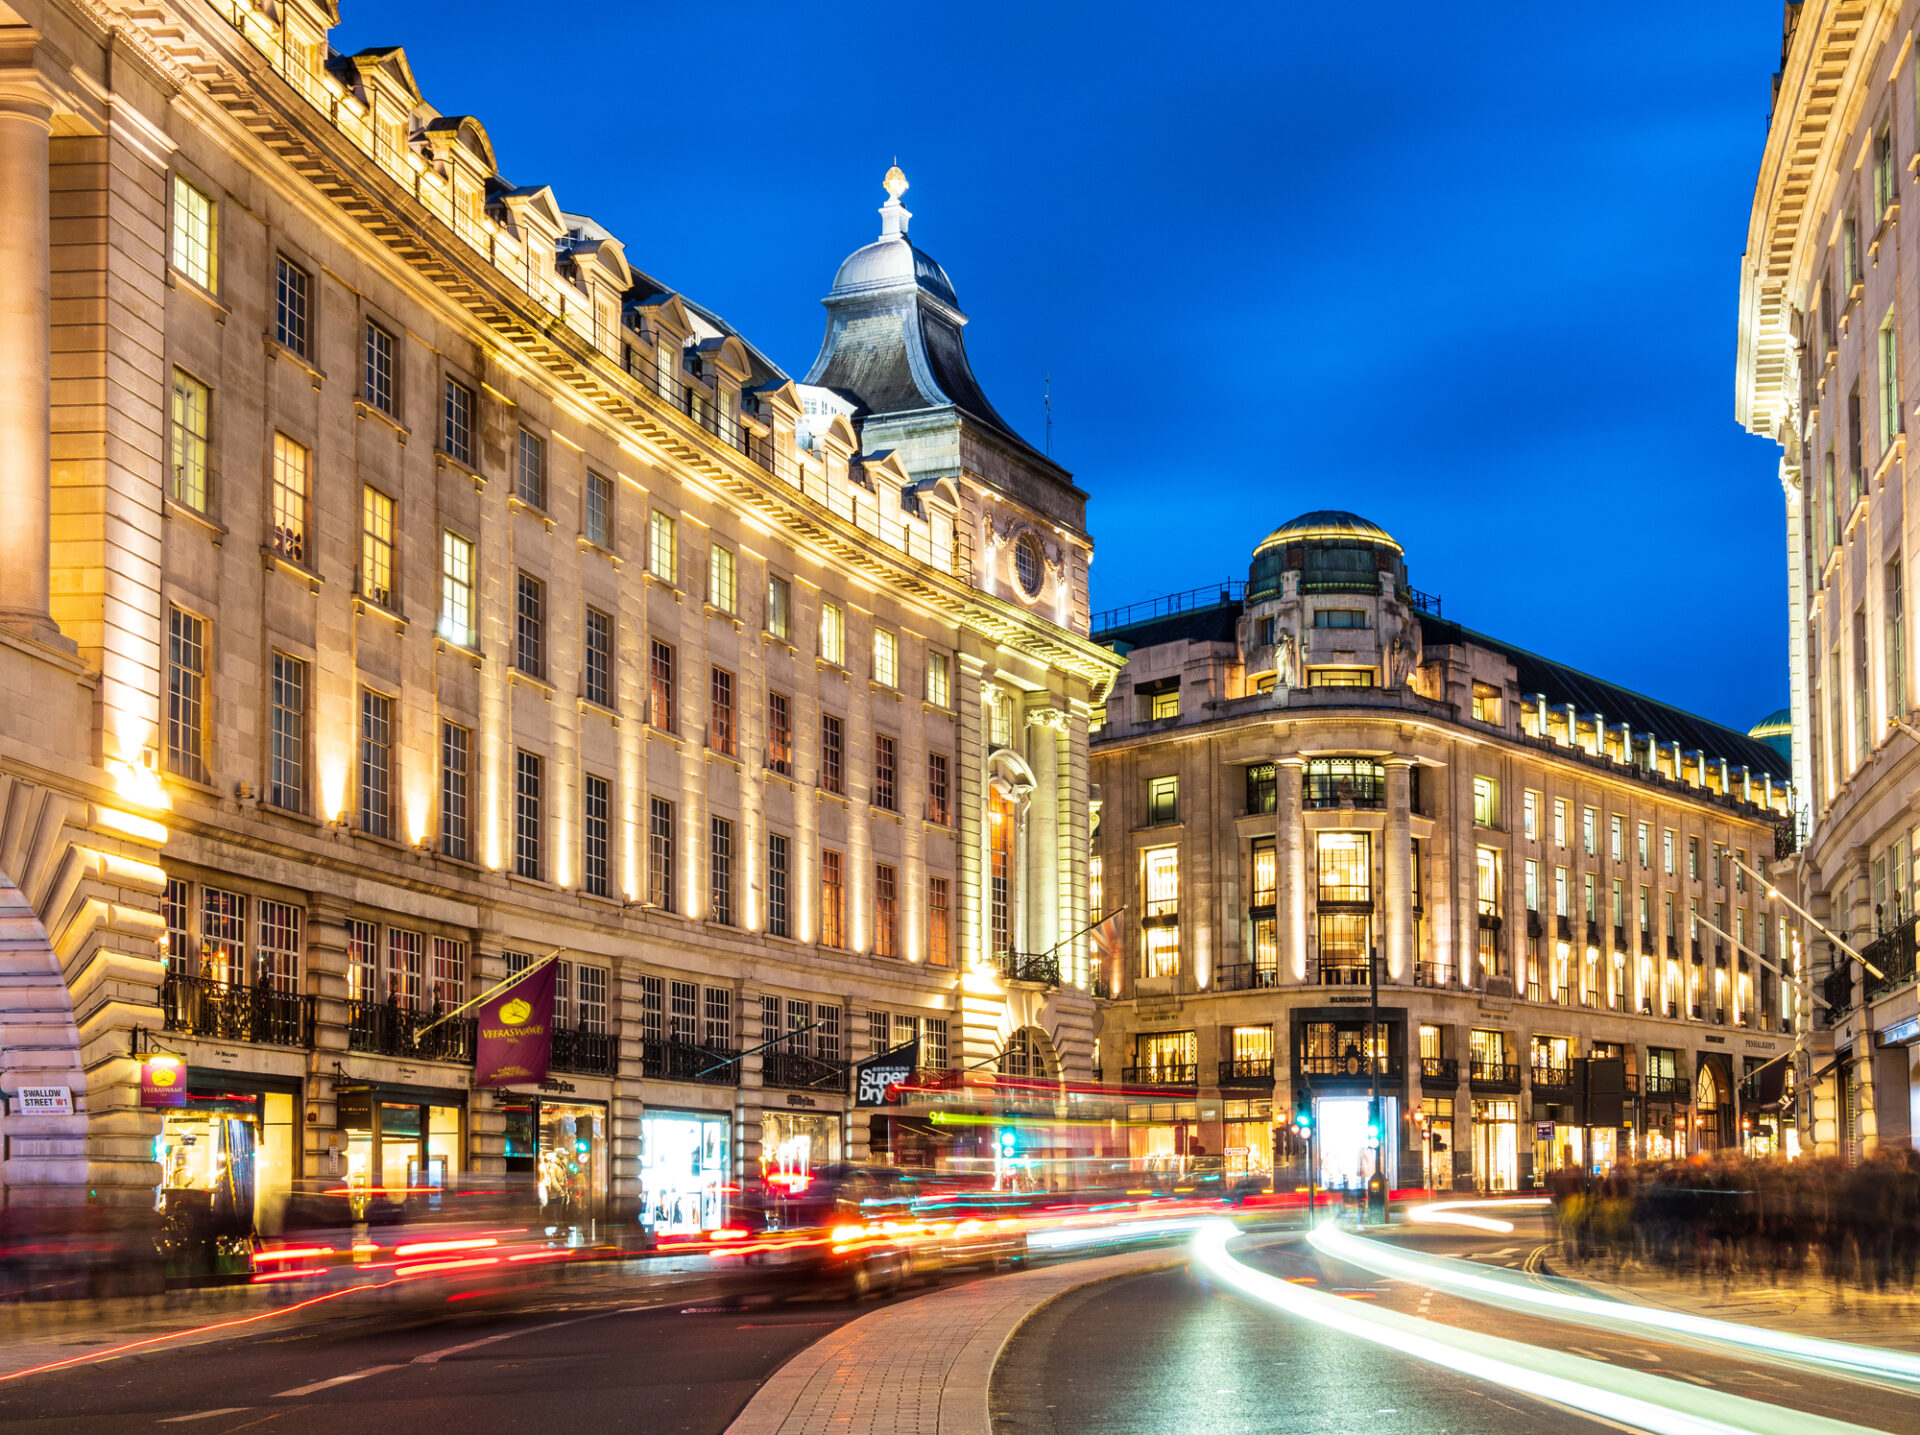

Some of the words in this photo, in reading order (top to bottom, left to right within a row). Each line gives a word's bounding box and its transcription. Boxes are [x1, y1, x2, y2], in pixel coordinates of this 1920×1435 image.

[860, 1069, 909, 1090] Super
[23, 1089, 61, 1098] SWALLOW
[859, 1085, 885, 1105] Dry
[24, 1098, 53, 1106] STREET
[55, 1098, 68, 1106] W1
[928, 1111, 945, 1124] 94
